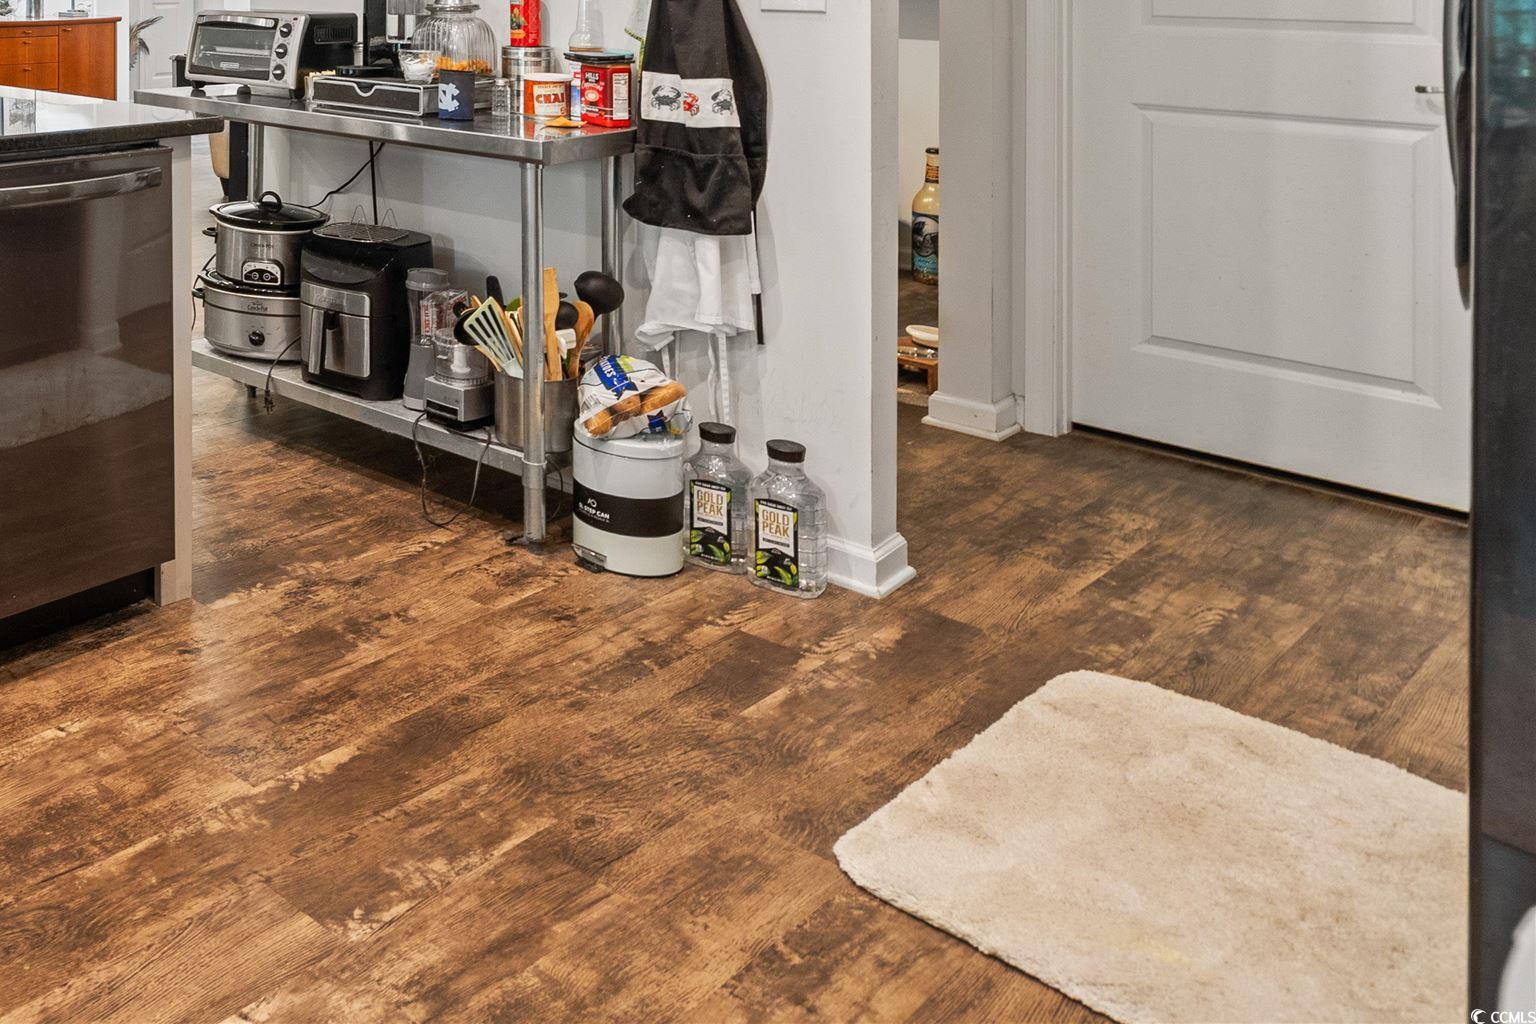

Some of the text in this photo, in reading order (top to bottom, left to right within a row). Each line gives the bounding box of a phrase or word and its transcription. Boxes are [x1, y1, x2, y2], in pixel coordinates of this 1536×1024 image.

[697, 489, 723, 505] GOLD
[596, 511, 610, 519] CAN
[697, 501, 723, 516] PEAK
[762, 509, 790, 526] GOLD
[762, 521, 790, 537] PEAK
